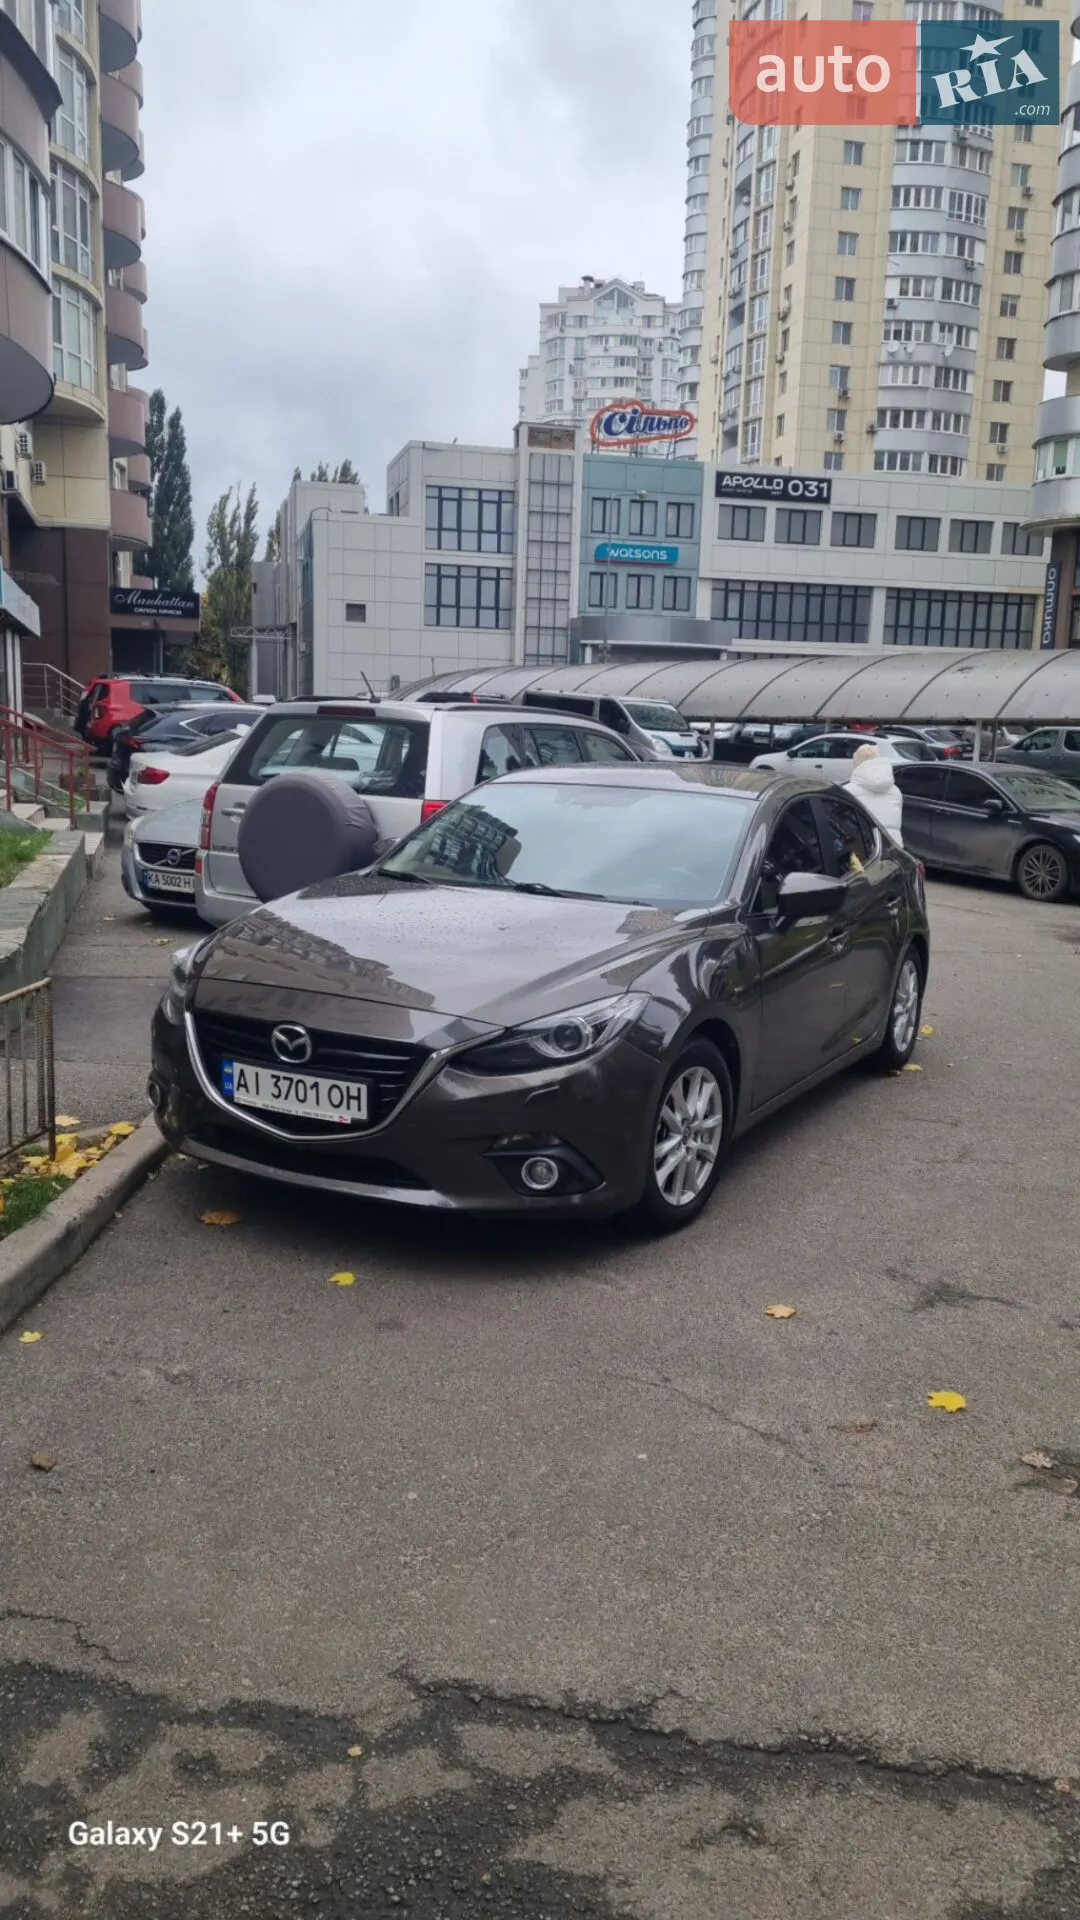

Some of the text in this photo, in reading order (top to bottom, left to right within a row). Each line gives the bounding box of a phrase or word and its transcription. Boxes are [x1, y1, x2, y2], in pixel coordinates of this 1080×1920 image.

[603, 407, 689, 437] Сільпо
[721, 475, 829, 498] APOLLO 031
[606, 547, 669, 561] watsons
[115, 590, 195, 608] Manhattan
[161, 874, 182, 888] 5002
[235, 1068, 260, 1096] AI
[270, 1073, 320, 1107] 3701
[327, 1083, 362, 1112] OH
